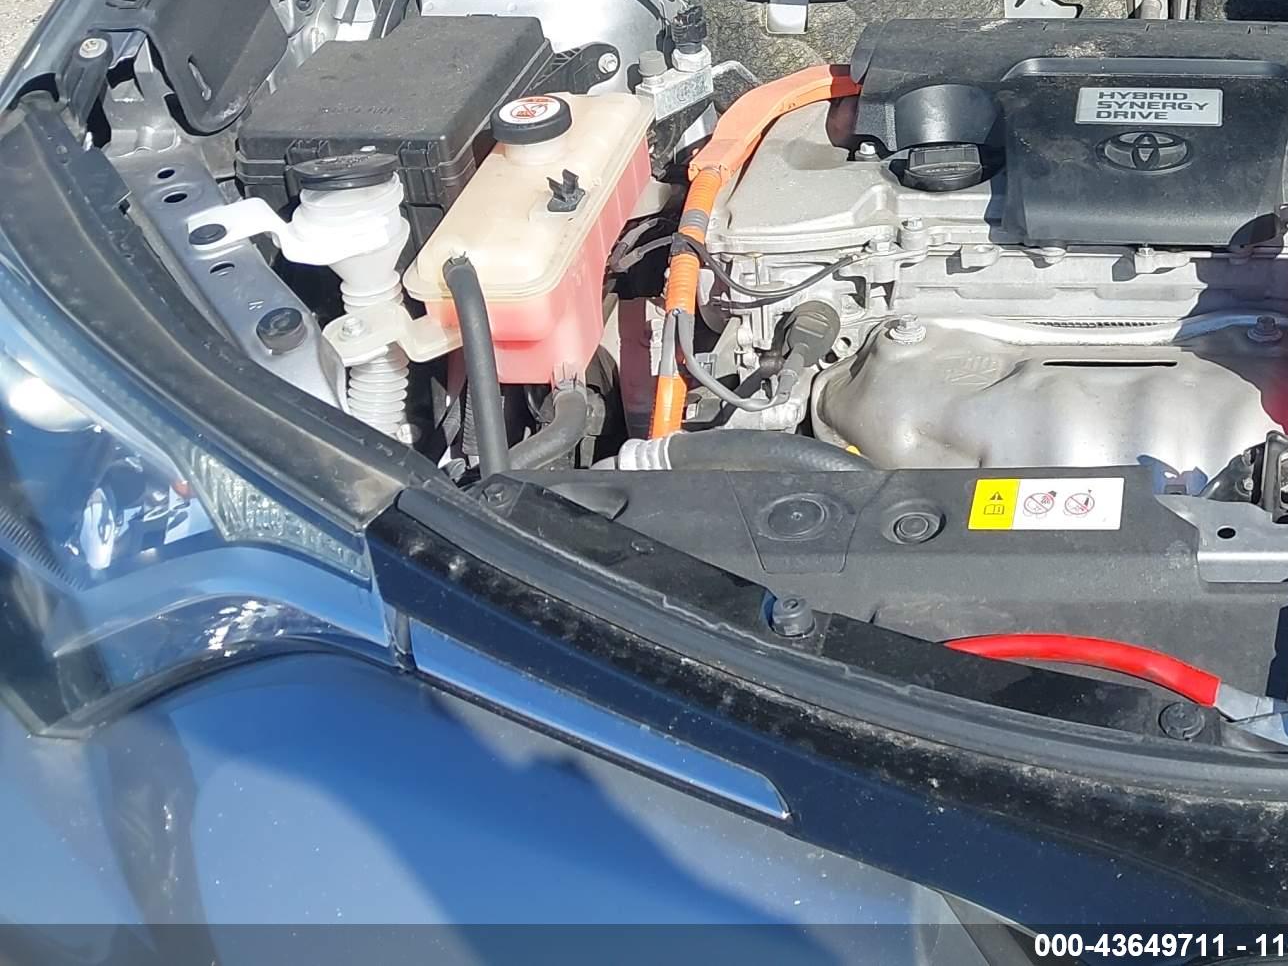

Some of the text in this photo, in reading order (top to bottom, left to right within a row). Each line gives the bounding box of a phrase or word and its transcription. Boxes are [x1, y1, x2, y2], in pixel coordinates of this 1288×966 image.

[1097, 91, 1188, 101] HYBRID
[1096, 100, 1209, 111] SYNERGY
[1095, 110, 1169, 120] DRIVE
